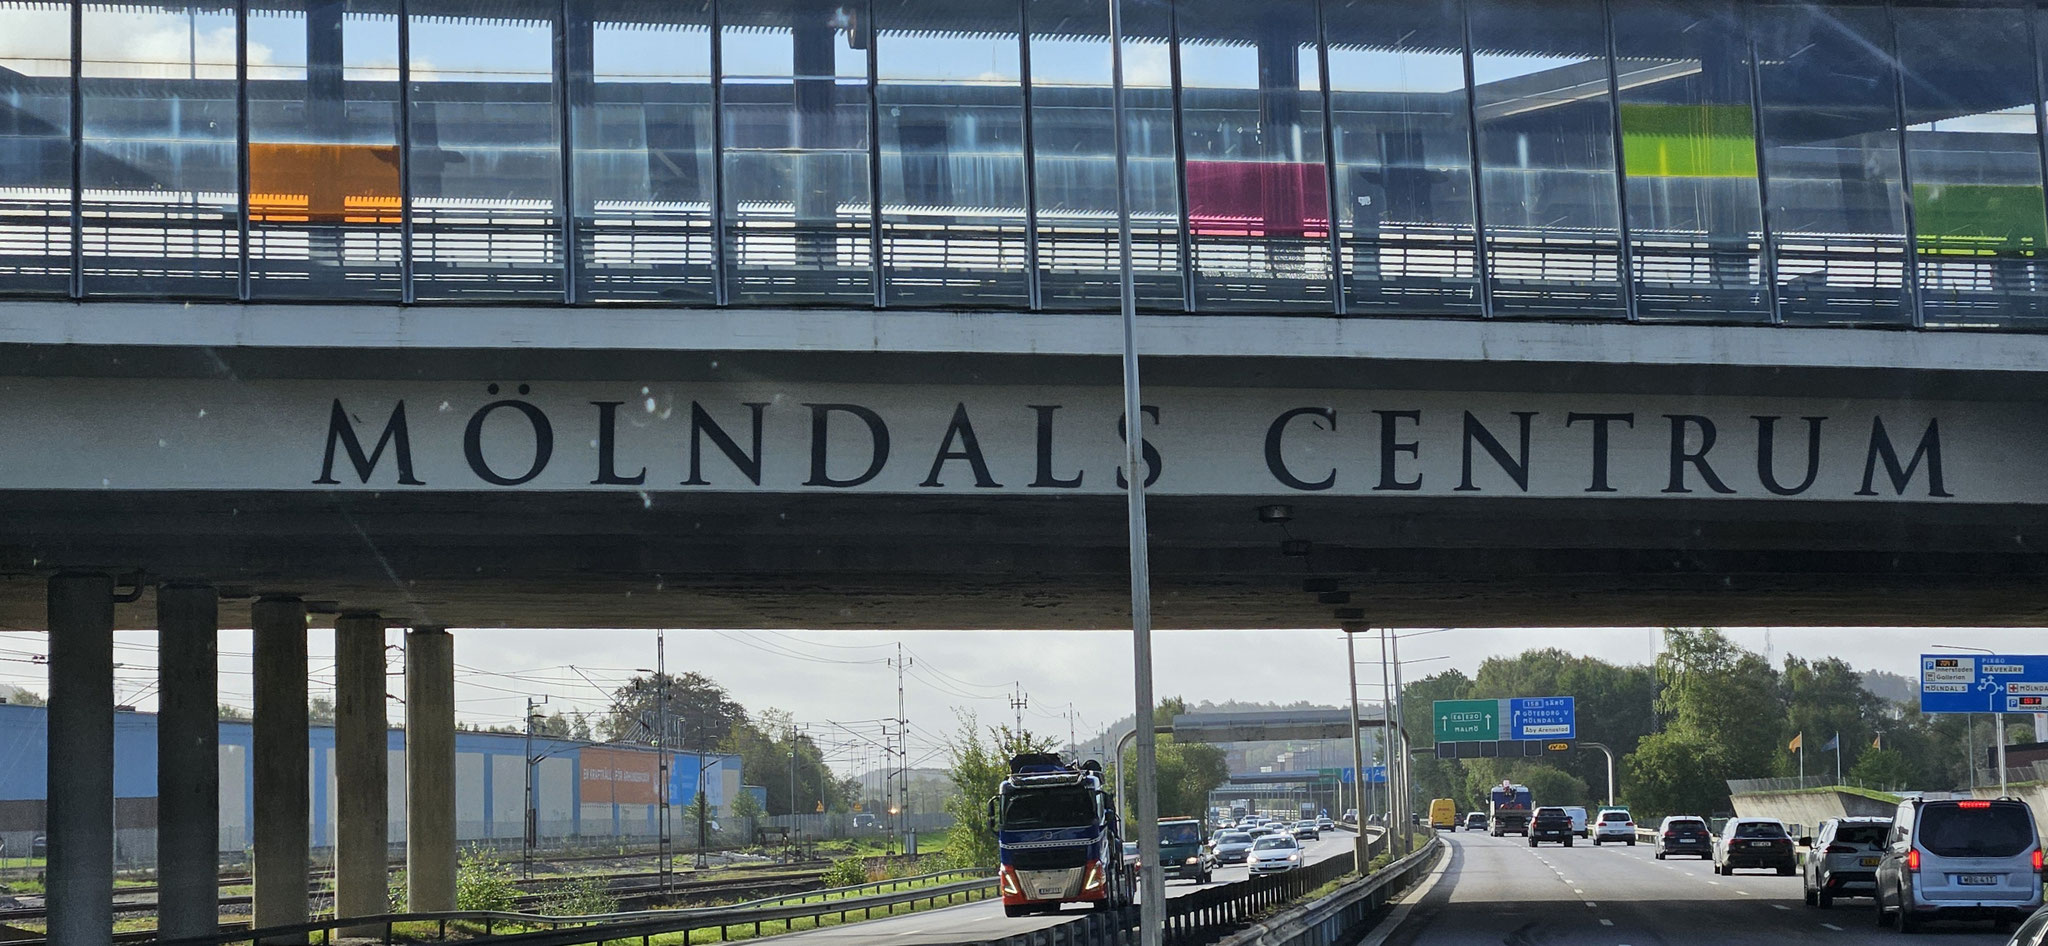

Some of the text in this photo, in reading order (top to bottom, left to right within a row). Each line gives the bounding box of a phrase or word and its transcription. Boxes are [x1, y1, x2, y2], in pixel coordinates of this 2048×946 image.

[311, 383, 1955, 497] MÖLNDALS CENTRUM
[1984, 665, 2022, 673] RÄVEKÄRR
